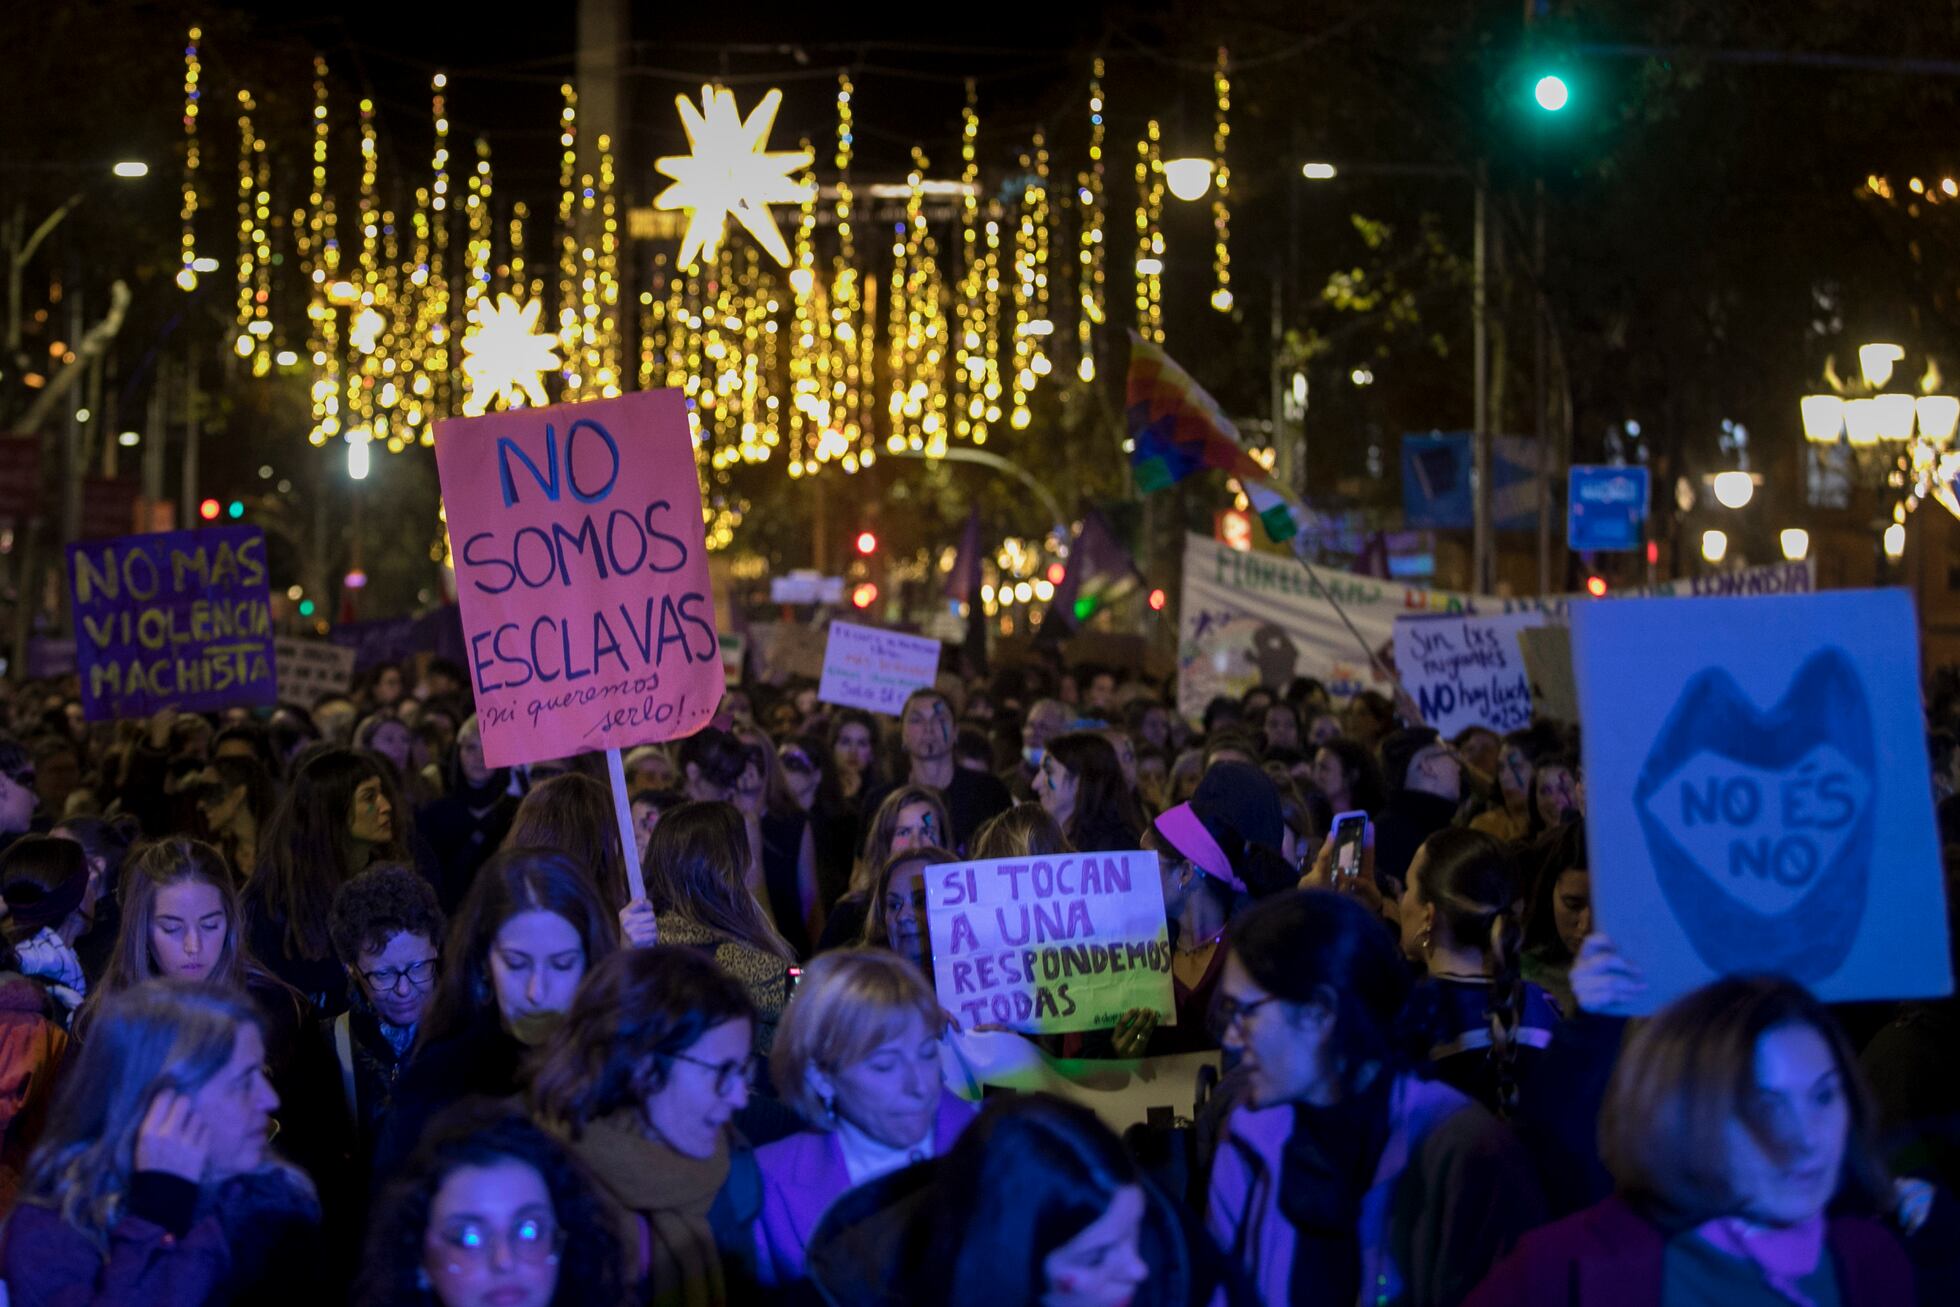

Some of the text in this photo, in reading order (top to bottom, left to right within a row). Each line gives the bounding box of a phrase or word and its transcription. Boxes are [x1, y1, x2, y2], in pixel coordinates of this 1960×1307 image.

[496, 418, 620, 508] NO
[75, 536, 265, 604] NO MAS
[463, 500, 688, 594] SOMOS
[83, 599, 272, 649] VIOLENCIA
[471, 592, 717, 695] ESCLAVAS
[1411, 629, 1453, 661] Sin
[90, 643, 270, 699] MACHISTA
[527, 672, 660, 729] queremos
[1419, 682, 1456, 723] NO
[1458, 680, 1490, 718] hay
[1680, 762, 1855, 831] NO ÉS
[942, 856, 1133, 907] SI TOCAN
[1728, 835, 1819, 888] NO
[950, 898, 1096, 955] A UNA
[952, 940, 1171, 995] RESPONDEMOS
[960, 983, 1077, 1026] TODAS
